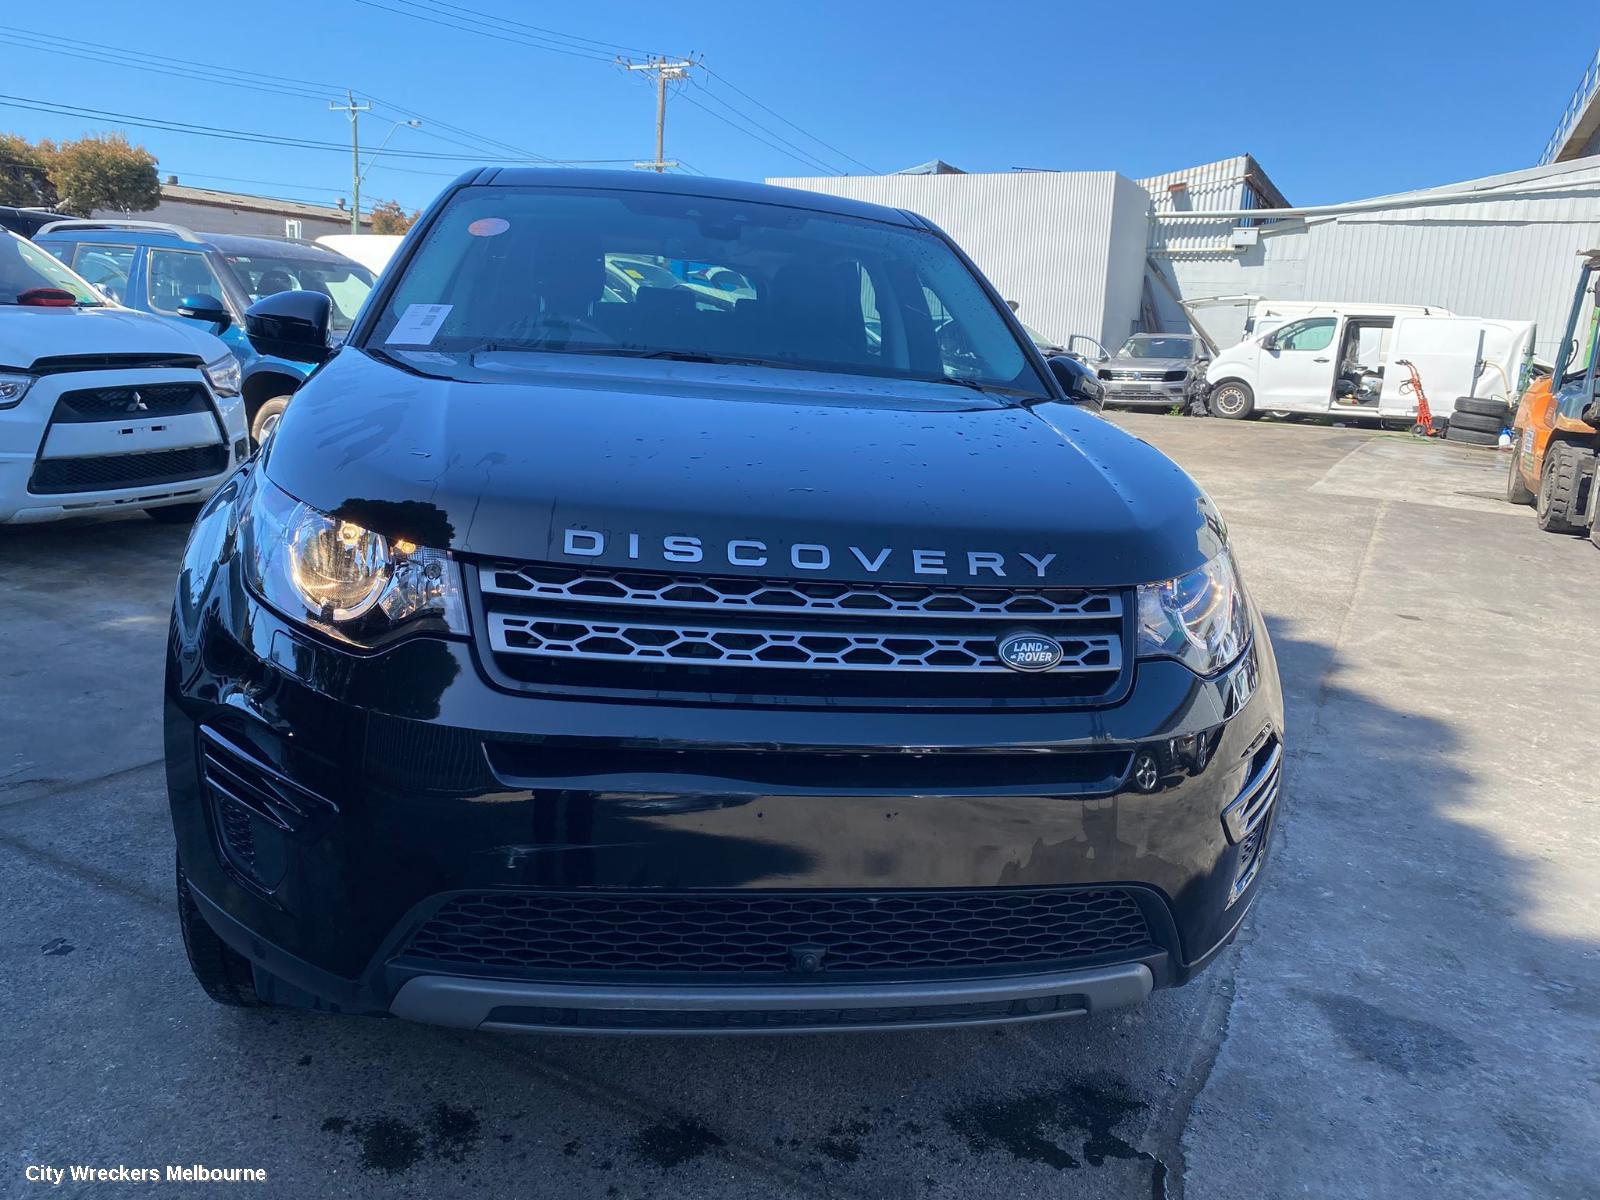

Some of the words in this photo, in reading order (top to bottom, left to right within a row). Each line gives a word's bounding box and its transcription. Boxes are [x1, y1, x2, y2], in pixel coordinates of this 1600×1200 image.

[563, 528, 1057, 578] DISCOVERY
[1013, 642, 1043, 652] LAND
[1017, 652, 1053, 662] ROVER
